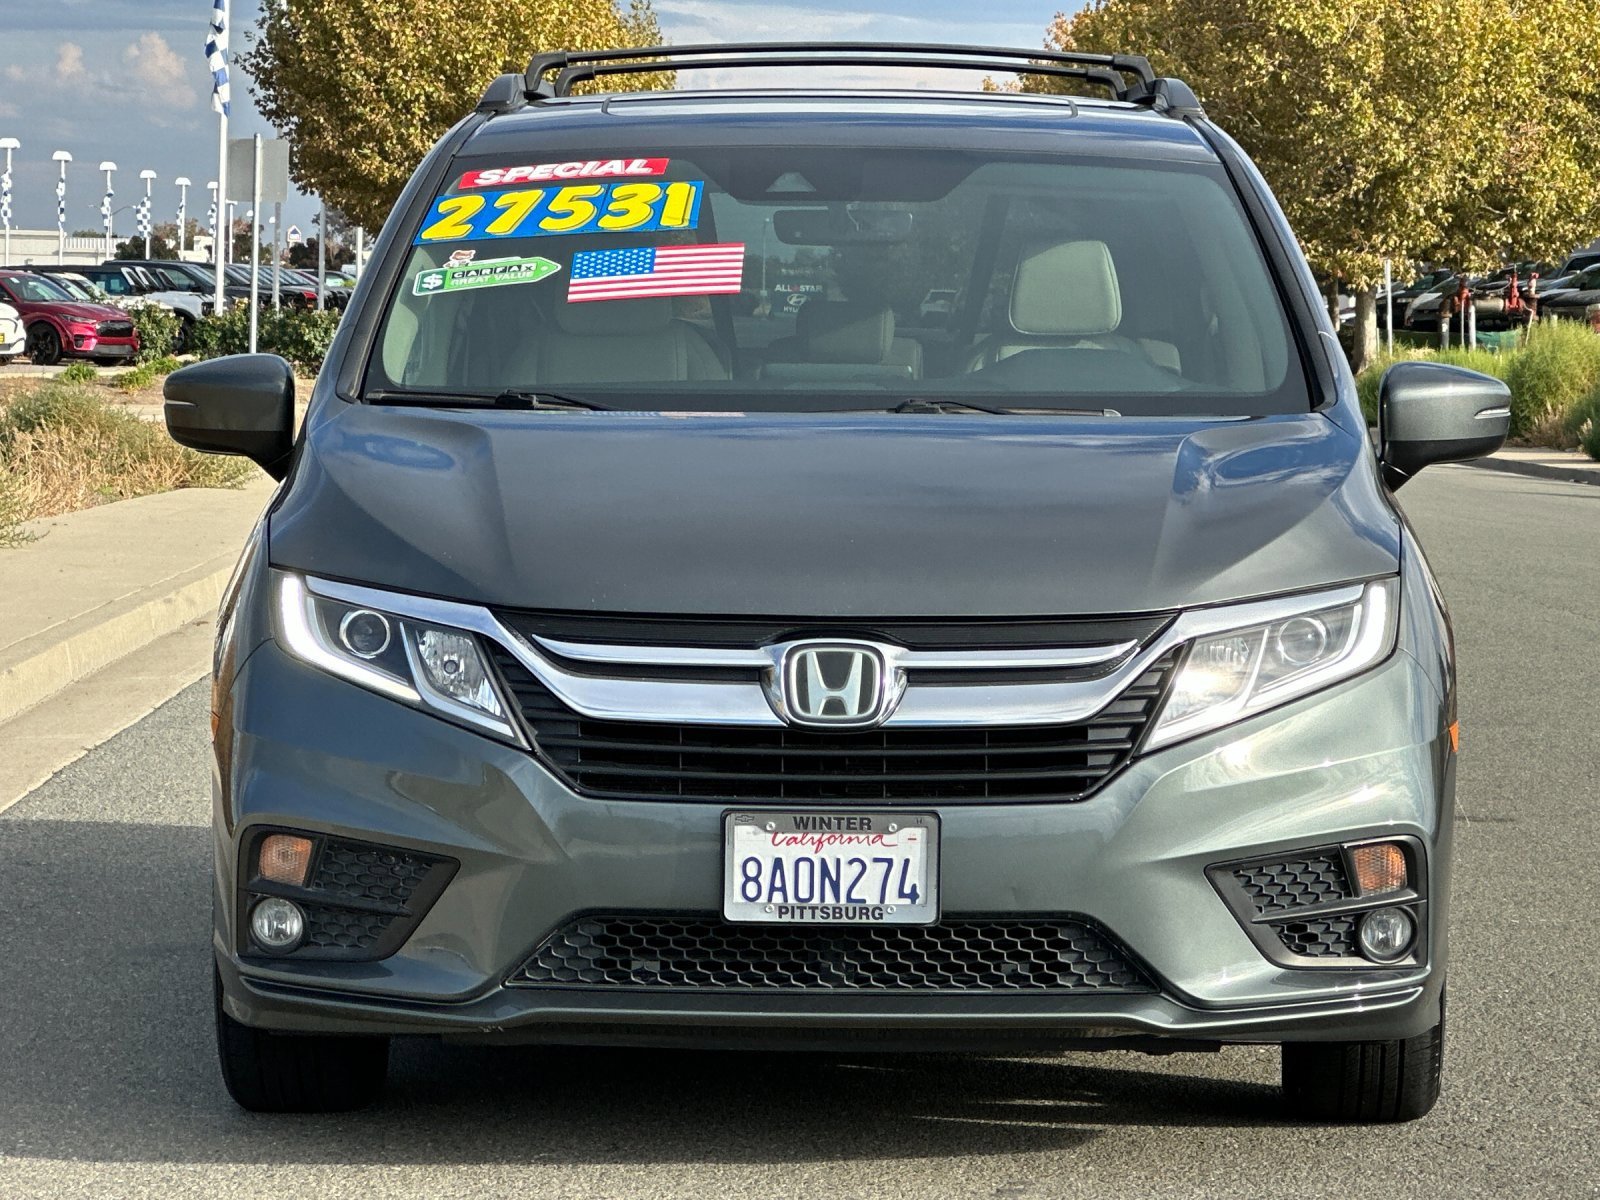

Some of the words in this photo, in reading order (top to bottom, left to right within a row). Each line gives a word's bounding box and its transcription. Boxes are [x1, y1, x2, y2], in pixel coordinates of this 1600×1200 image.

[473, 158, 653, 186] SPECIAL
[421, 182, 697, 241] 27531
[451, 275, 492, 287] GREAT
[494, 270, 534, 282] VALUE
[452, 262, 537, 279] CARFAX
[774, 284, 792, 292] ALL
[793, 816, 872, 831] WINTER
[771, 831, 898, 855] California
[778, 905, 884, 921] PITTSBURG
